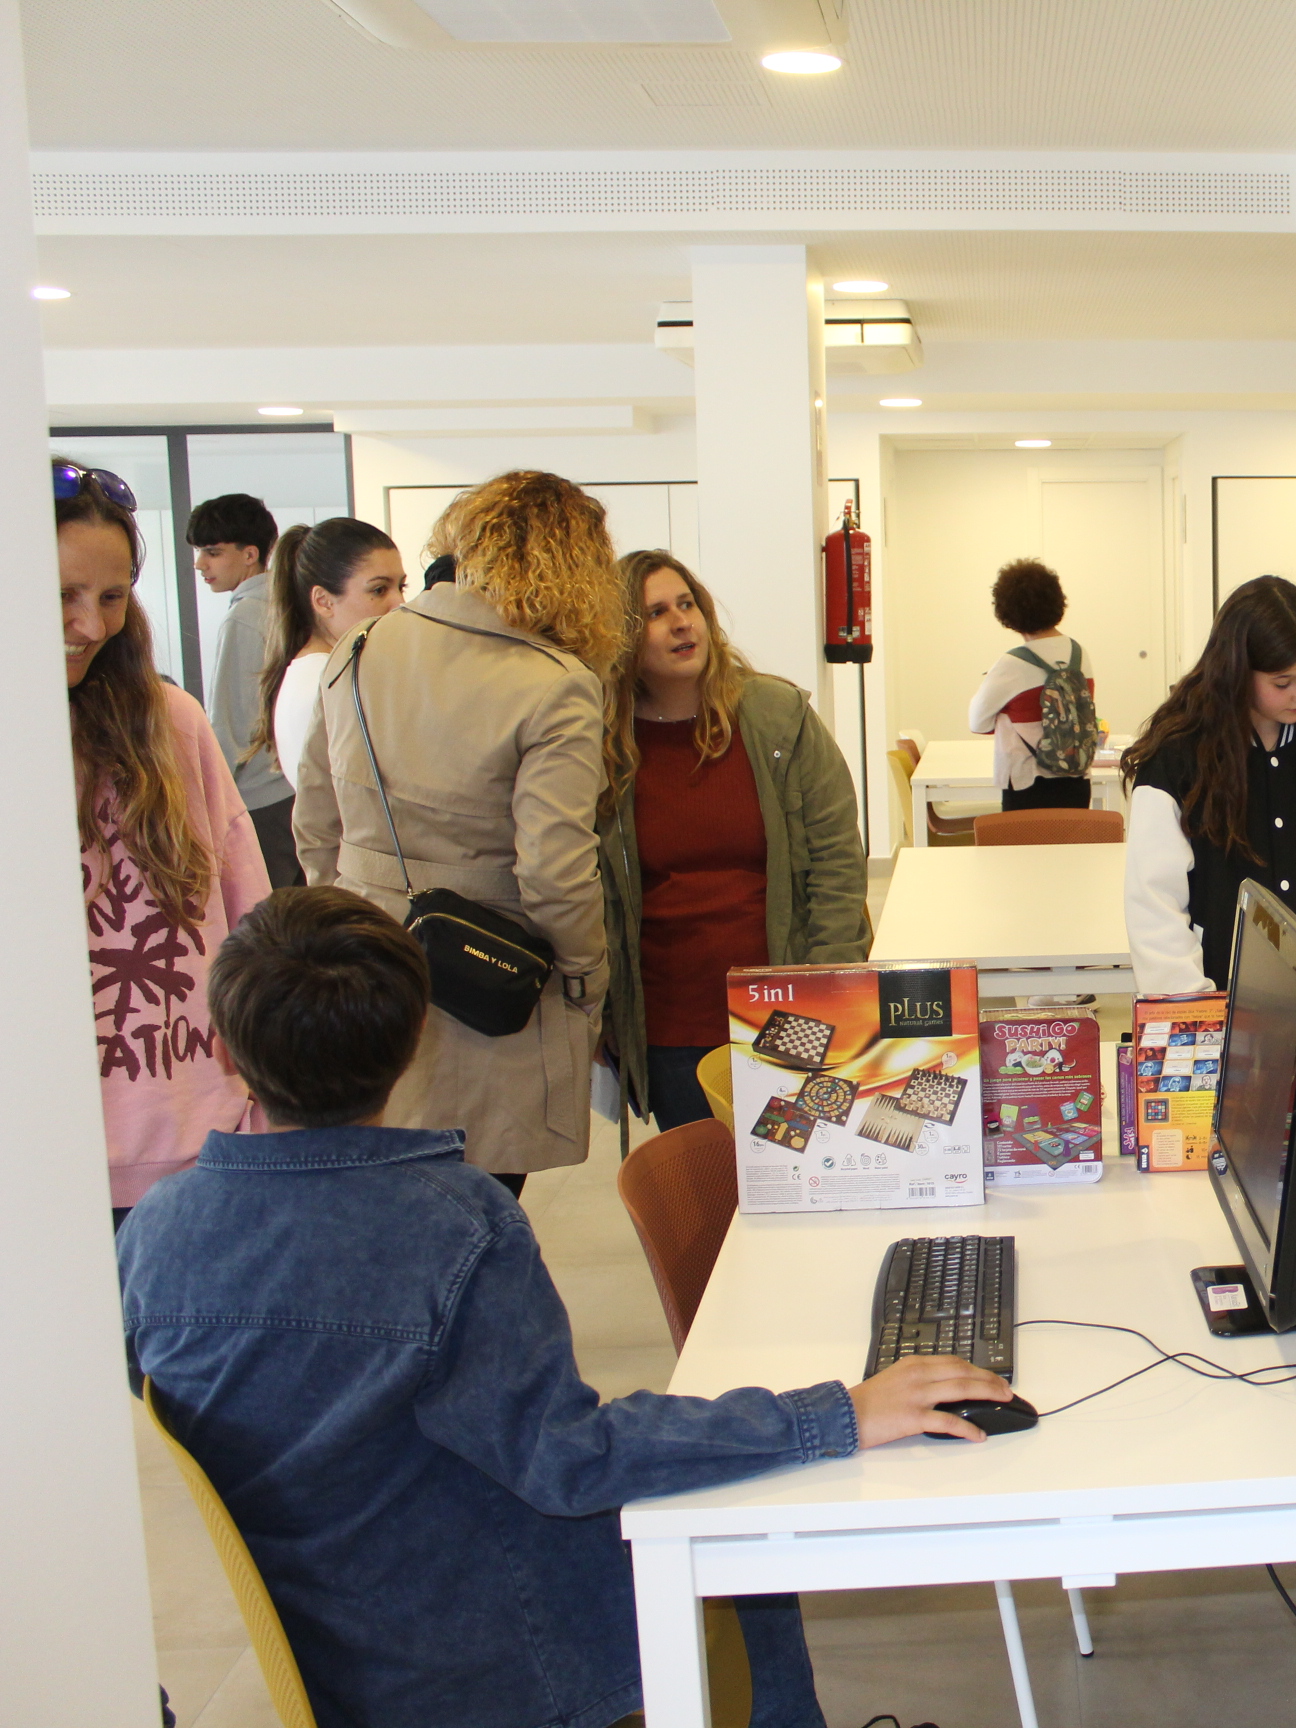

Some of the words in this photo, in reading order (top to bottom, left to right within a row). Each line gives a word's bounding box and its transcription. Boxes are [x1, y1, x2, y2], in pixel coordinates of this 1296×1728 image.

[464, 944, 489, 962] BIMBA
[498, 960, 518, 973] LOLA
[748, 985, 759, 1002] 5
[764, 986, 783, 1002] in
[1005, 1036, 1066, 1052] PARTY!
[944, 1173, 967, 1182] cayro
